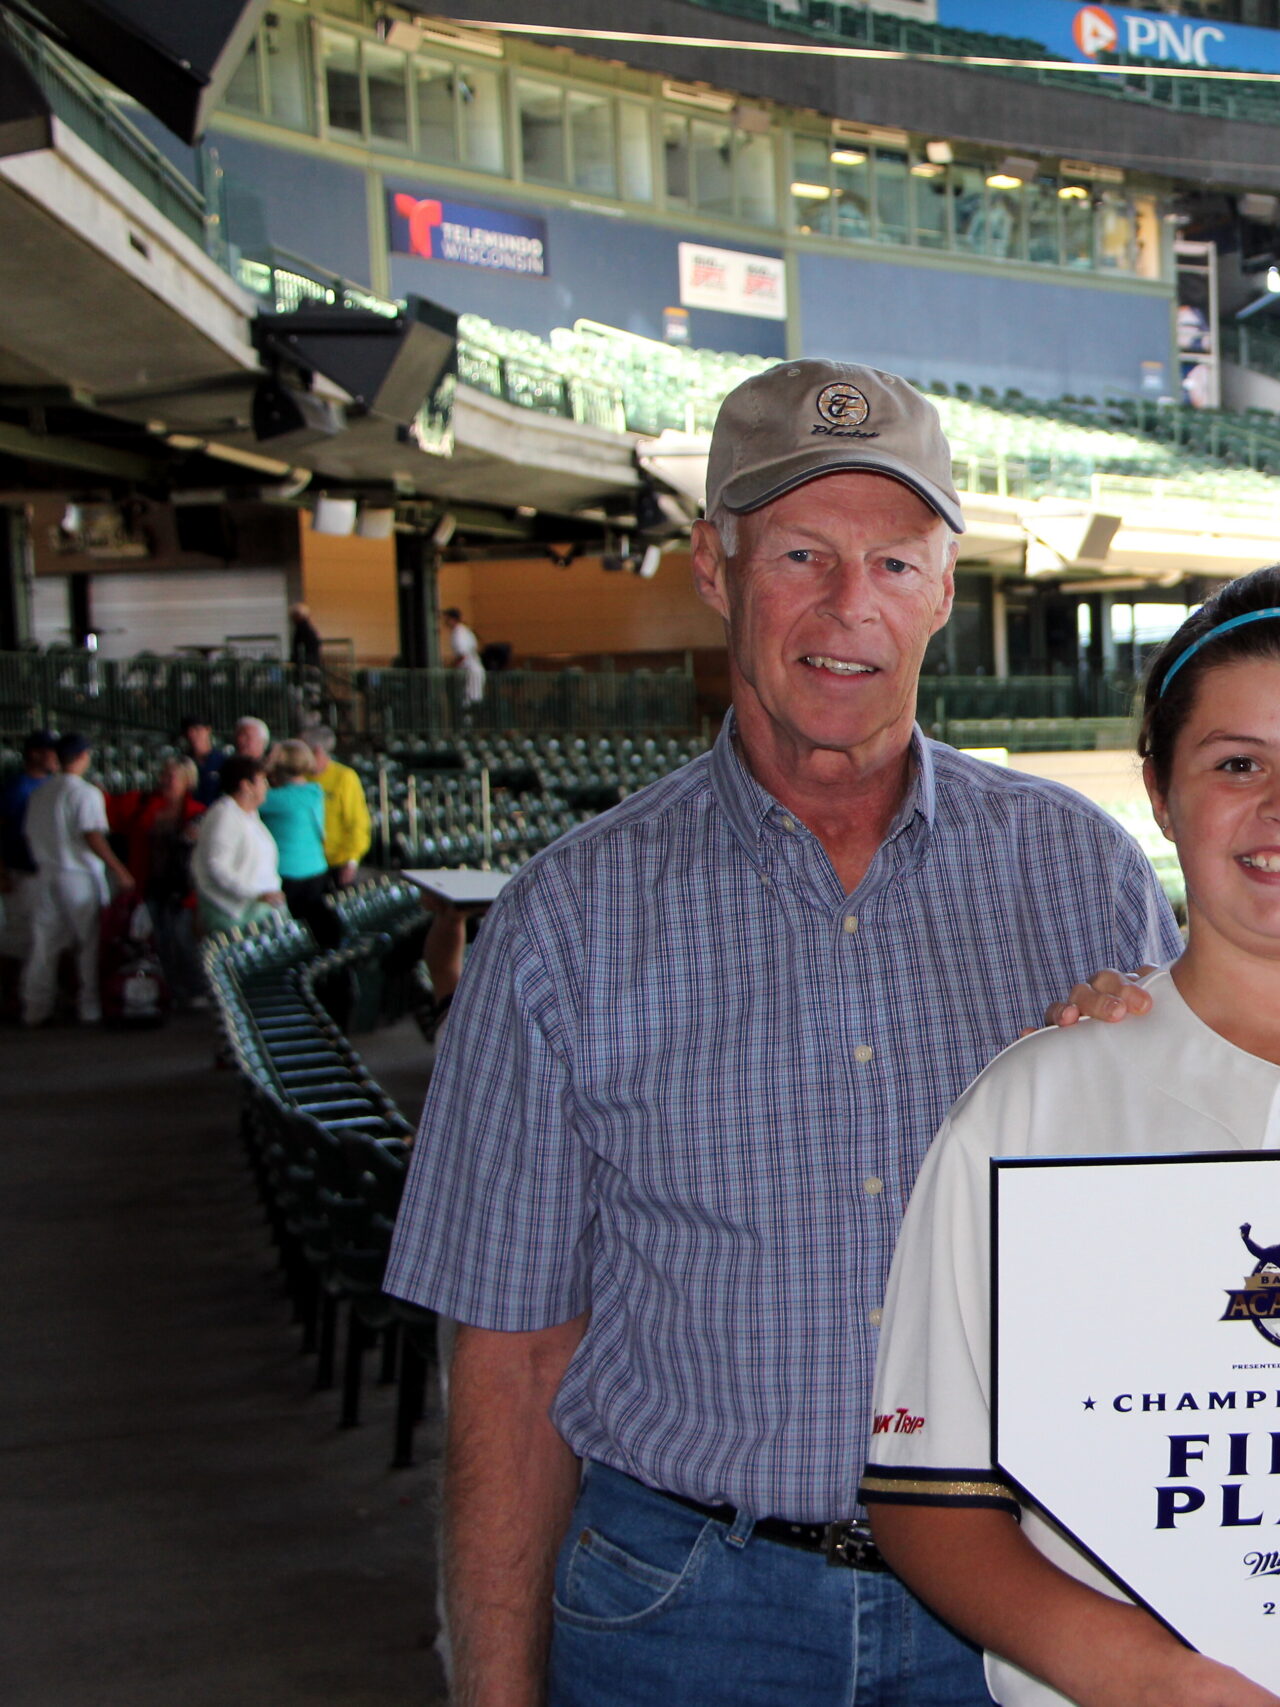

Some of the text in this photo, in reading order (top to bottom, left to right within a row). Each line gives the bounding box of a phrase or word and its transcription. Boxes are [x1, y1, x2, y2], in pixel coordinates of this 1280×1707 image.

[1123, 15, 1225, 67] PNC
[441, 222, 544, 257] TELEMUNDO
[441, 239, 545, 275] WISCONSIN
